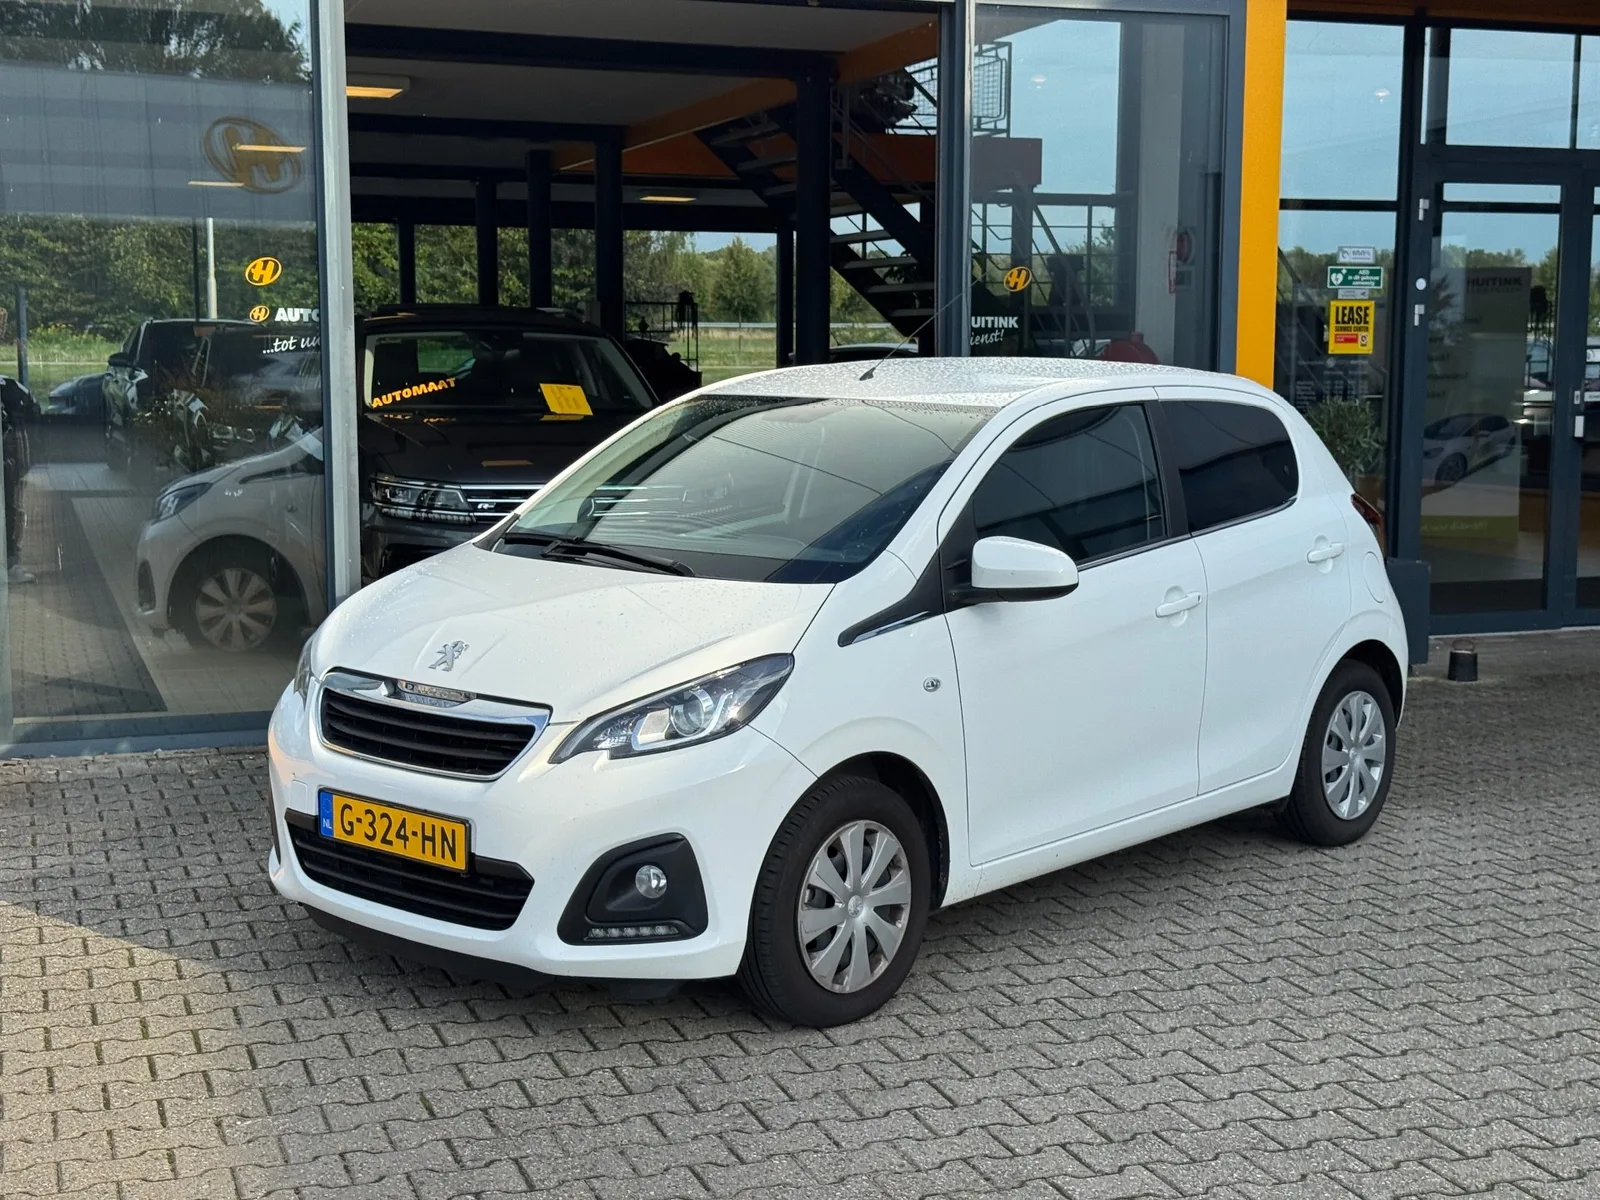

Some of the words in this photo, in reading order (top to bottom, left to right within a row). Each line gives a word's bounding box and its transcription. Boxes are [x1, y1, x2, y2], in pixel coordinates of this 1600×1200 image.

[1335, 306, 1369, 325] LEASE
[372, 377, 456, 408] AUTOMAAT
[322, 817, 332, 830] NL
[340, 803, 457, 863] G-324-HN
